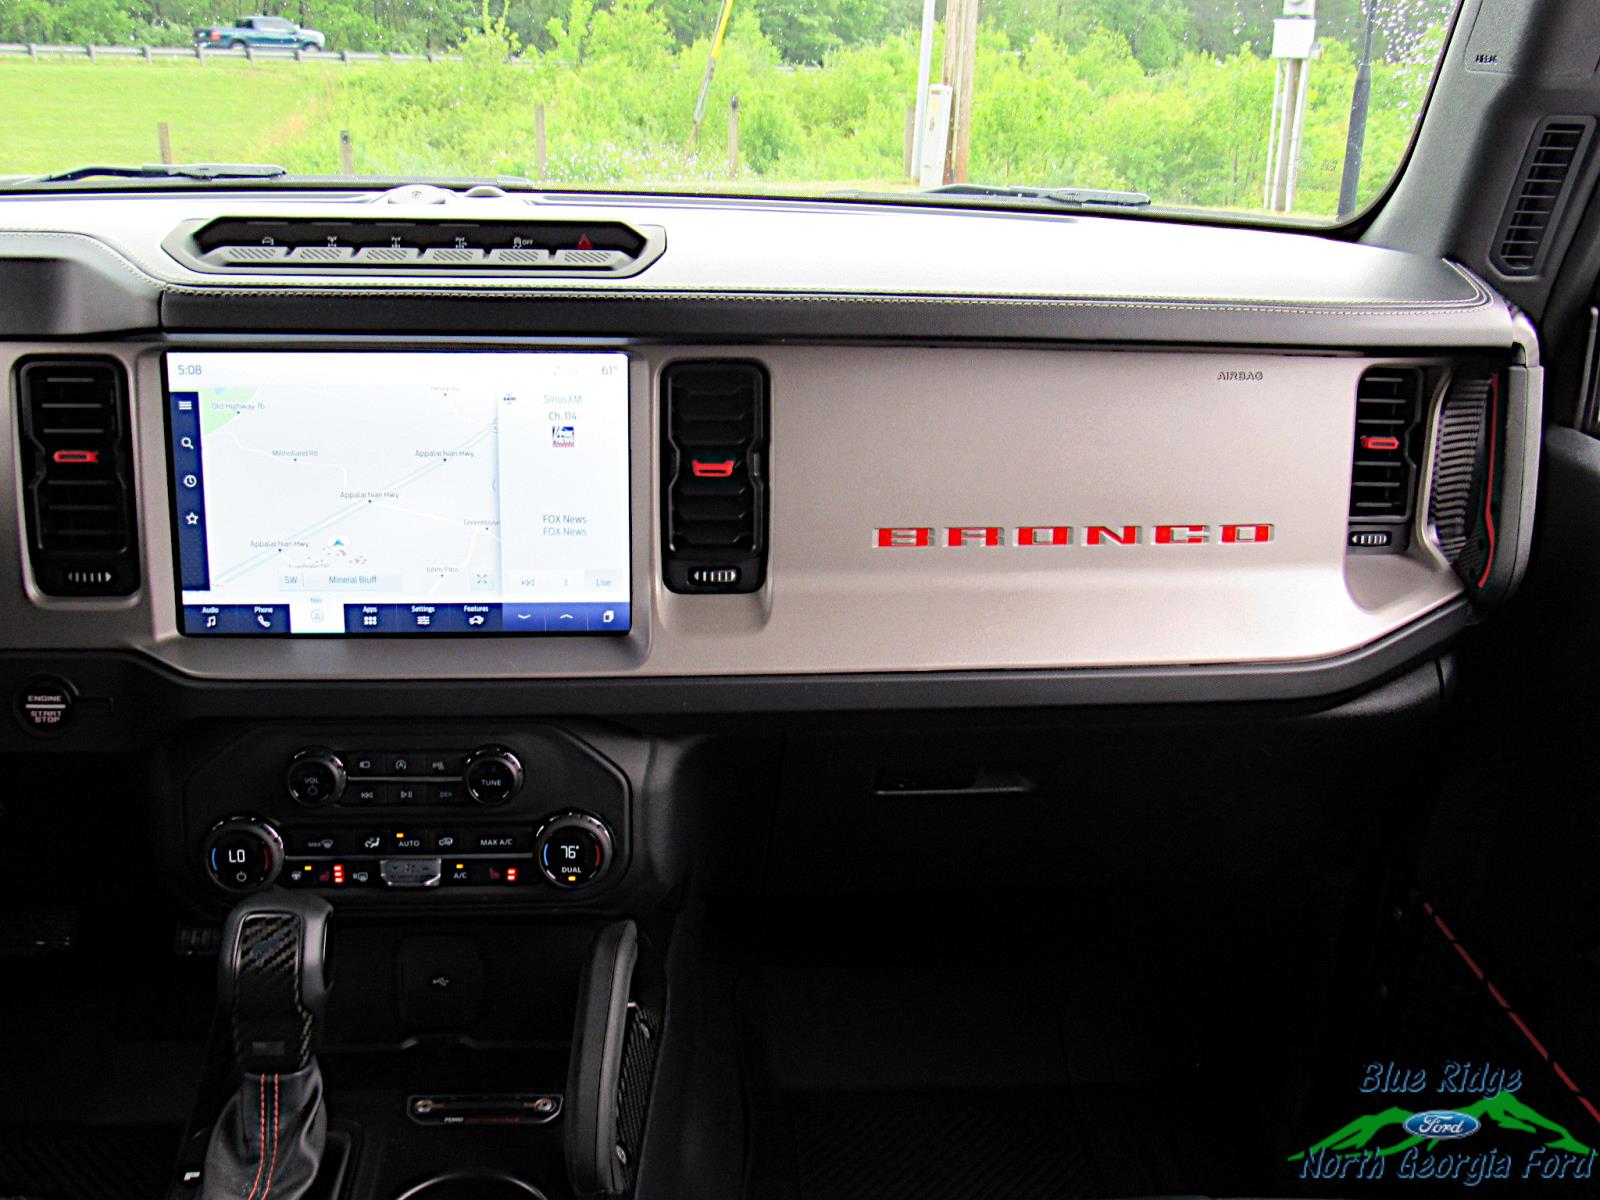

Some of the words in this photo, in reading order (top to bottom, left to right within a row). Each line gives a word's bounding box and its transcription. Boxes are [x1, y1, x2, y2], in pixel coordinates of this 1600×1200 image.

[177, 364, 202, 376] 5:08
[1216, 371, 1264, 381] AIRBAG
[543, 394, 583, 404] SiriusXM
[548, 411, 562, 421] Ch.
[564, 411, 577, 421] 114
[415, 449, 457, 458] Appalachian
[459, 449, 474, 458] Hwy
[340, 491, 382, 499] Appalachian
[384, 491, 399, 499] Hwy
[543, 514, 561, 524] FOX
[563, 514, 587, 524] News
[543, 527, 561, 536] FOX
[563, 527, 587, 537] News
[872, 523, 1275, 548] BRONCO
[250, 540, 292, 549] Appalachian
[294, 540, 309, 549] Hwy
[328, 575, 356, 584] Mineral
[357, 575, 377, 584] Bluff
[595, 577, 612, 587] Live
[202, 606, 219, 614] Audio
[254, 606, 273, 614] Phone
[362, 605, 378, 614] Apps
[411, 604, 435, 614] Settings
[463, 604, 489, 613] Features
[398, 839, 420, 847] AUTO
[480, 838, 498, 846] MAX
[499, 838, 512, 846] A/C
[561, 865, 582, 874] DUAL
[453, 871, 467, 879] A/C
